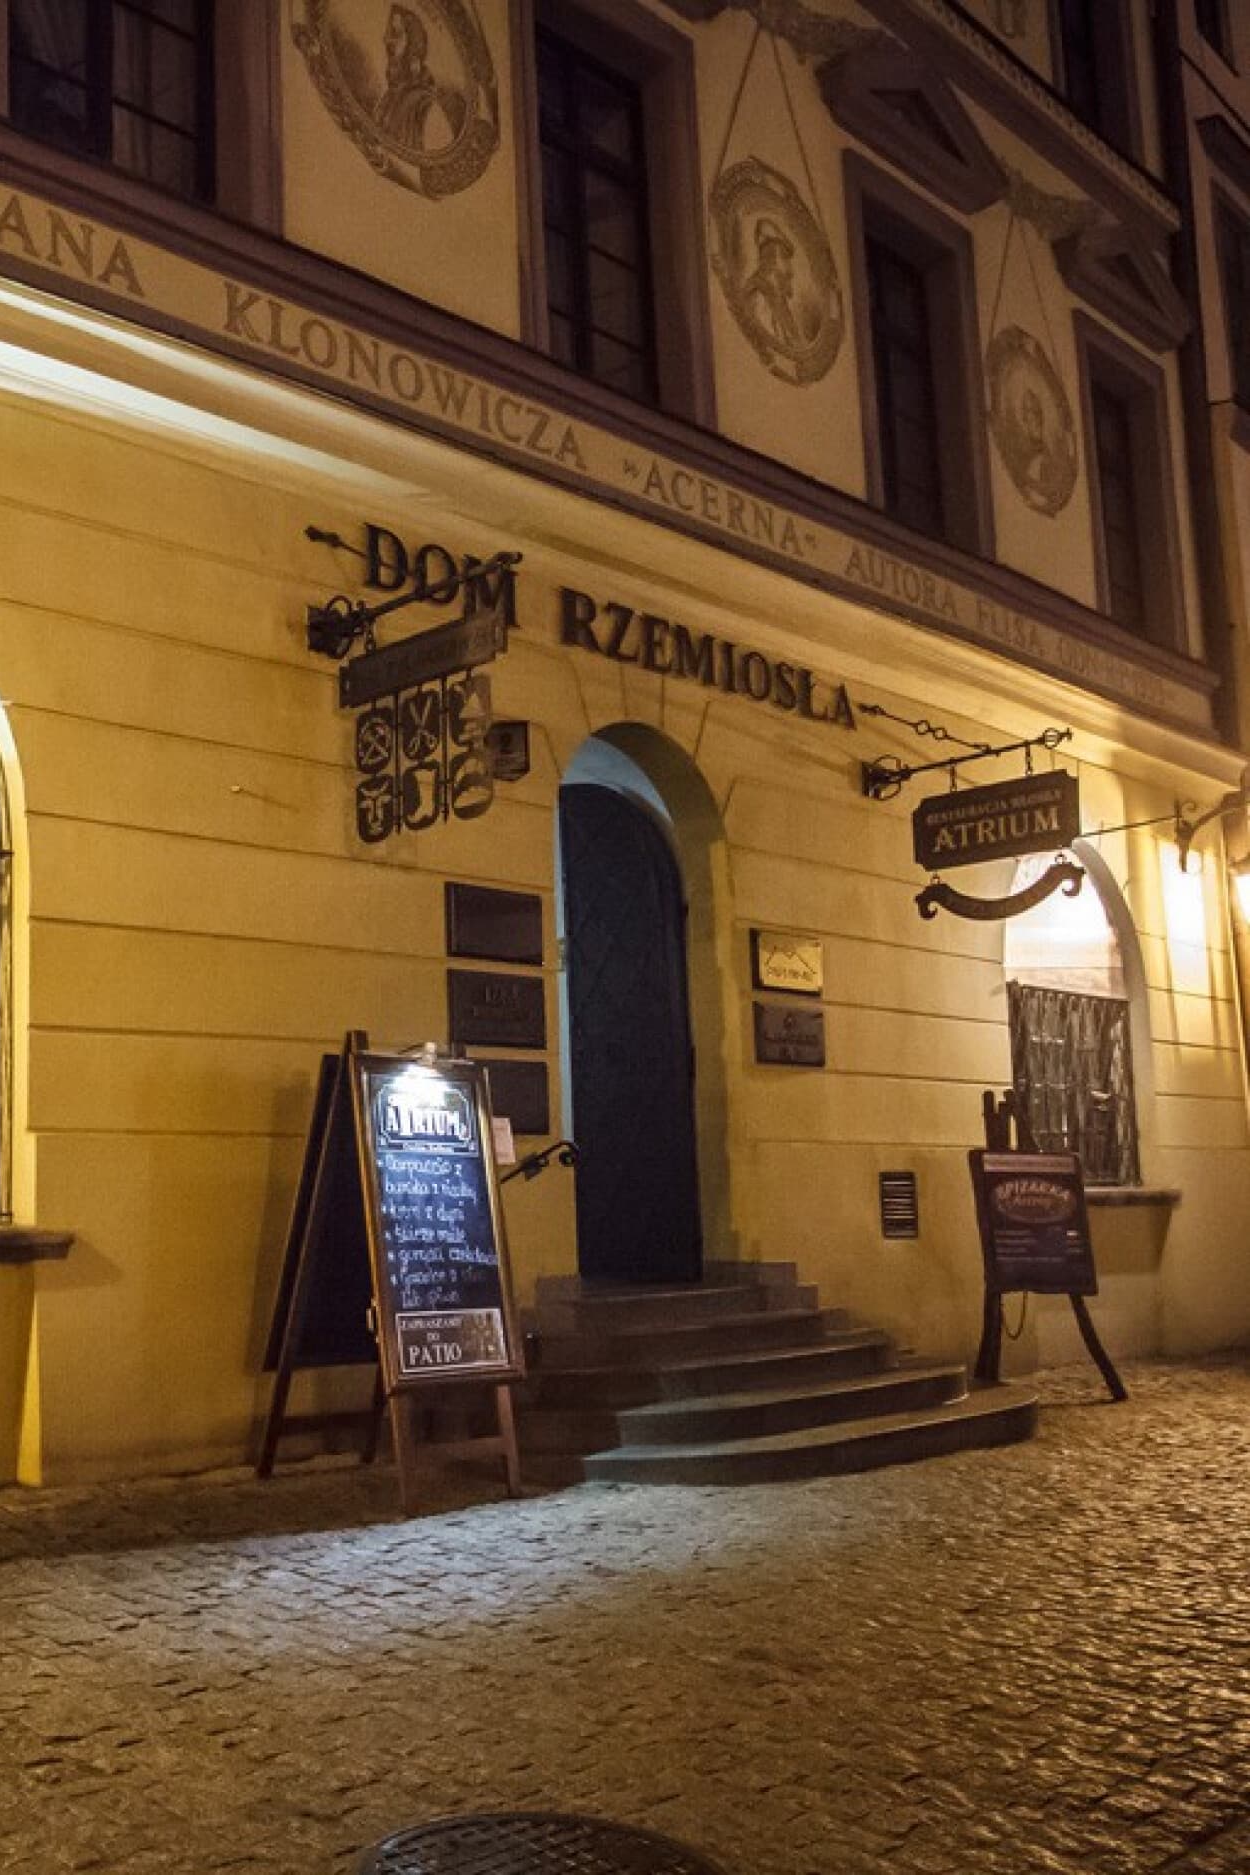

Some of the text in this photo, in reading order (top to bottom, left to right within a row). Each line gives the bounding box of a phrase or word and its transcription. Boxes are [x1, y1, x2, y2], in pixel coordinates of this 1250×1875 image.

[223, 281, 587, 470] KLONOWICZA
[844, 545, 958, 620] AUTORA
[363, 522, 856, 731] DOM RZEMIOSŁA
[934, 807, 1061, 853] ATRIUM
[409, 1342, 463, 1366] PATIO
